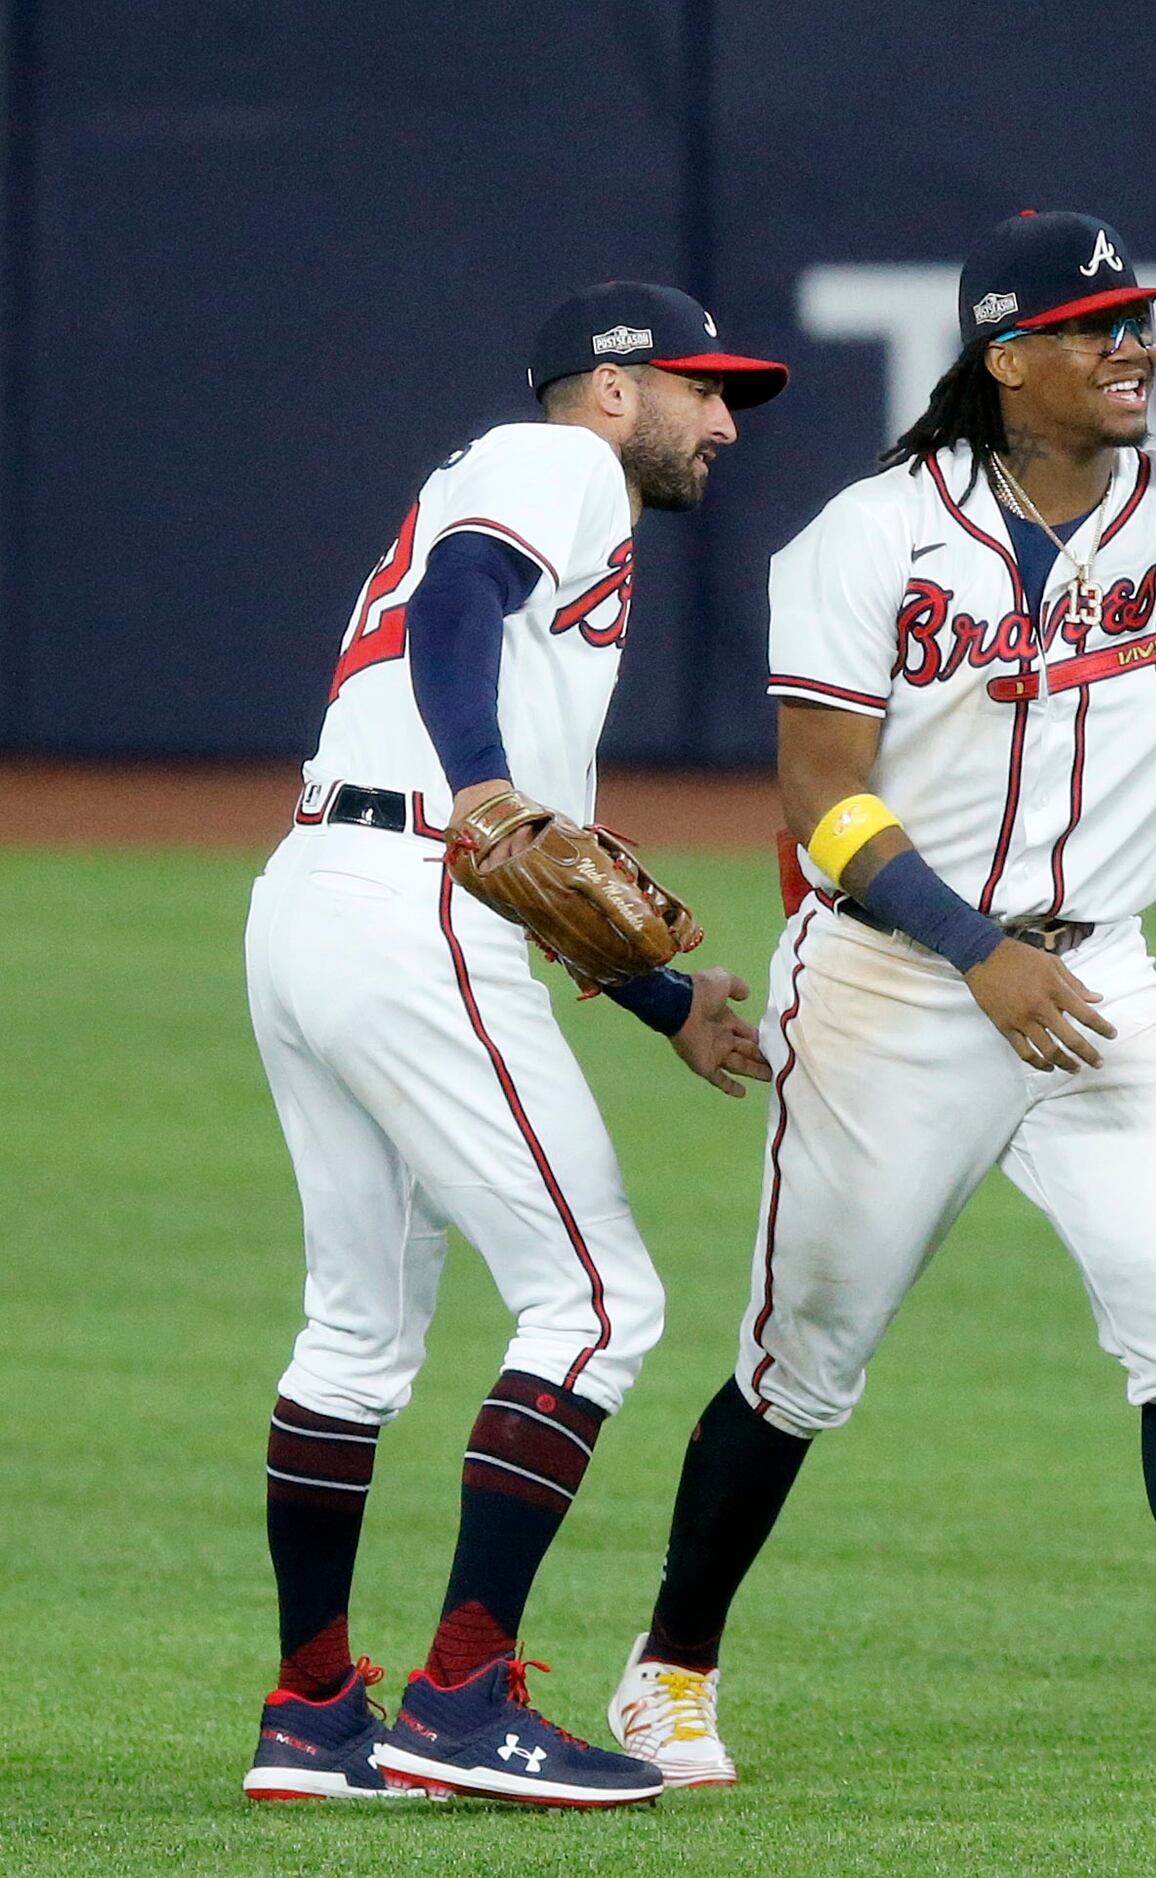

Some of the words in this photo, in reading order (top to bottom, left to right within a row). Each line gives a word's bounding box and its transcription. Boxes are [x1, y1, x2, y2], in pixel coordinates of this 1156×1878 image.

[1079, 228, 1123, 277] A
[596, 331, 649, 351] POSTSEASON
[1066, 580, 1102, 626] 13
